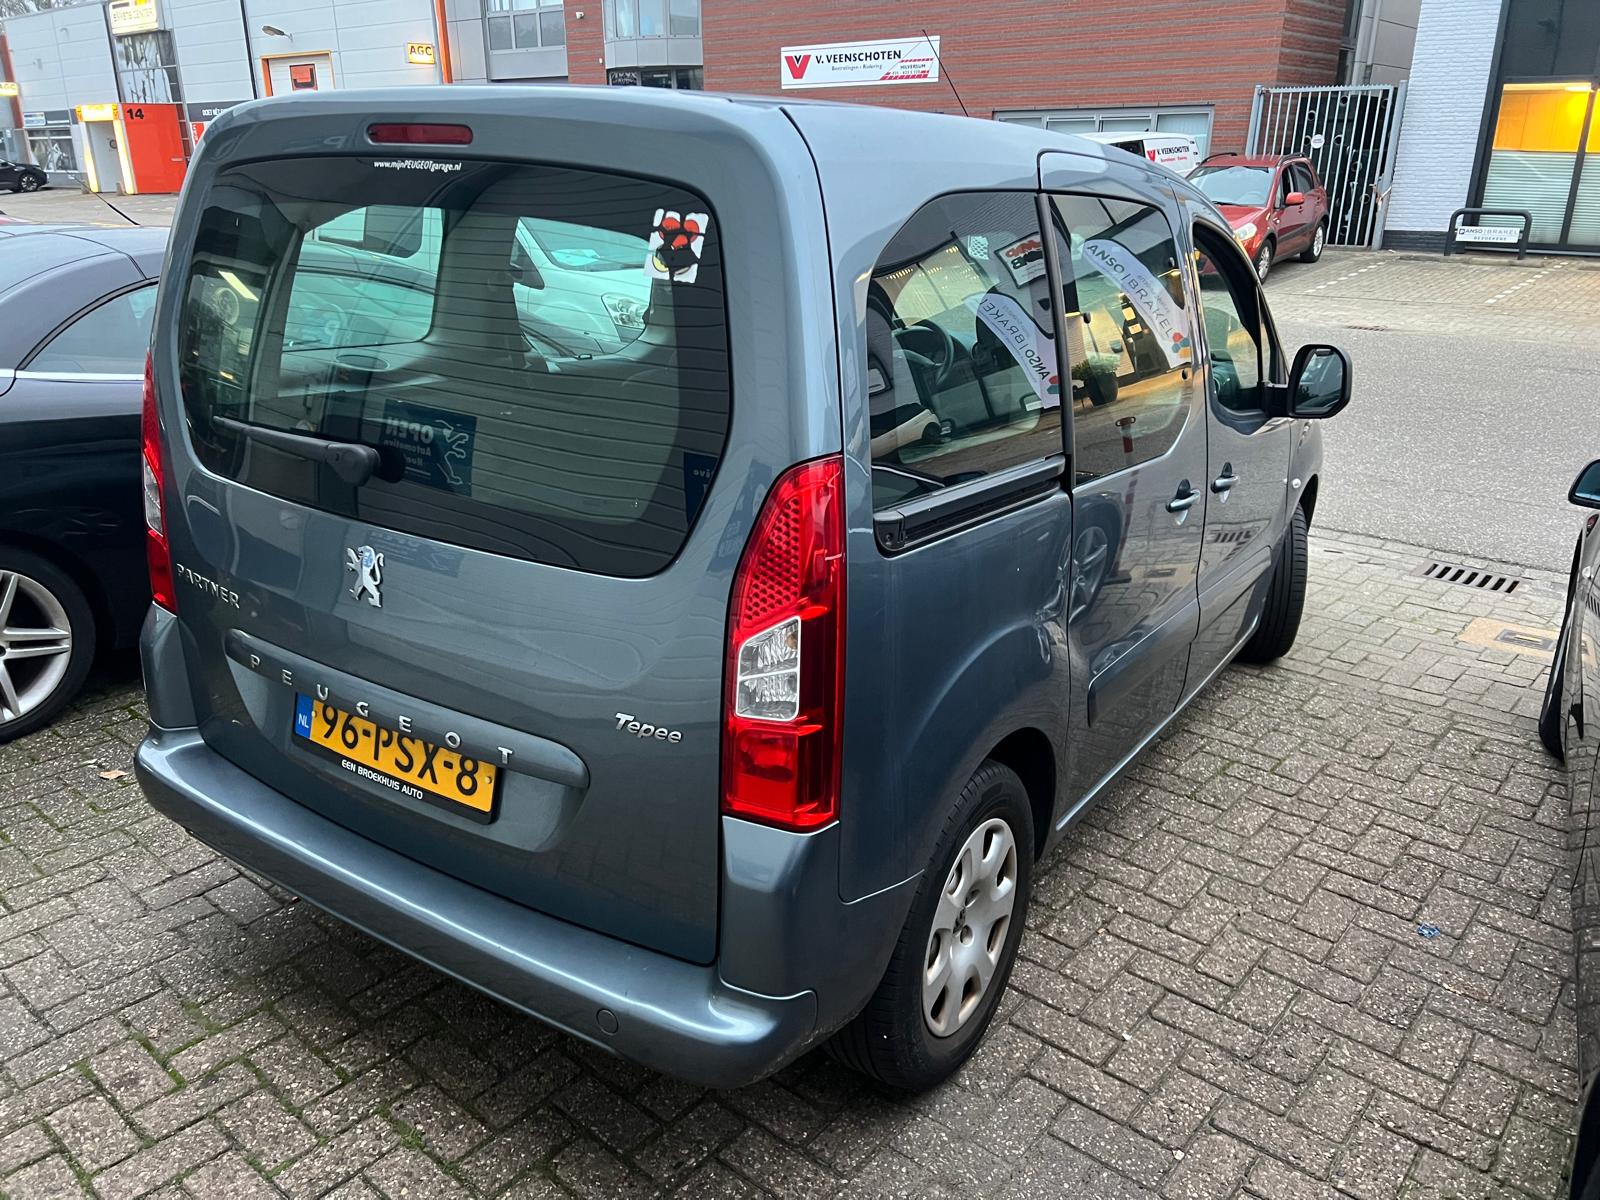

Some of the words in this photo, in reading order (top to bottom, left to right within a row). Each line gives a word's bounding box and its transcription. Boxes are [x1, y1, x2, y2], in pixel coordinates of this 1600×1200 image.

[409, 45, 433, 56] AGC
[815, 55, 824, 64] V.
[826, 49, 901, 64] VEENSCHOTEN
[126, 108, 144, 120] 14
[373, 159, 462, 173] www.mijnPEUGEOTgarage.nl
[1087, 244, 1125, 274] ANSO
[1127, 278, 1174, 338] BRAKEL
[176, 562, 240, 609] PARTNER
[250, 654, 513, 764] PEUGEOT
[298, 713, 310, 729] NL
[615, 712, 682, 744] Tepee
[322, 703, 479, 797] 96-PSX-8
[341, 758, 356, 773] EEN
[357, 765, 400, 791] BROEKHUIS
[401, 784, 424, 800] AUTO
